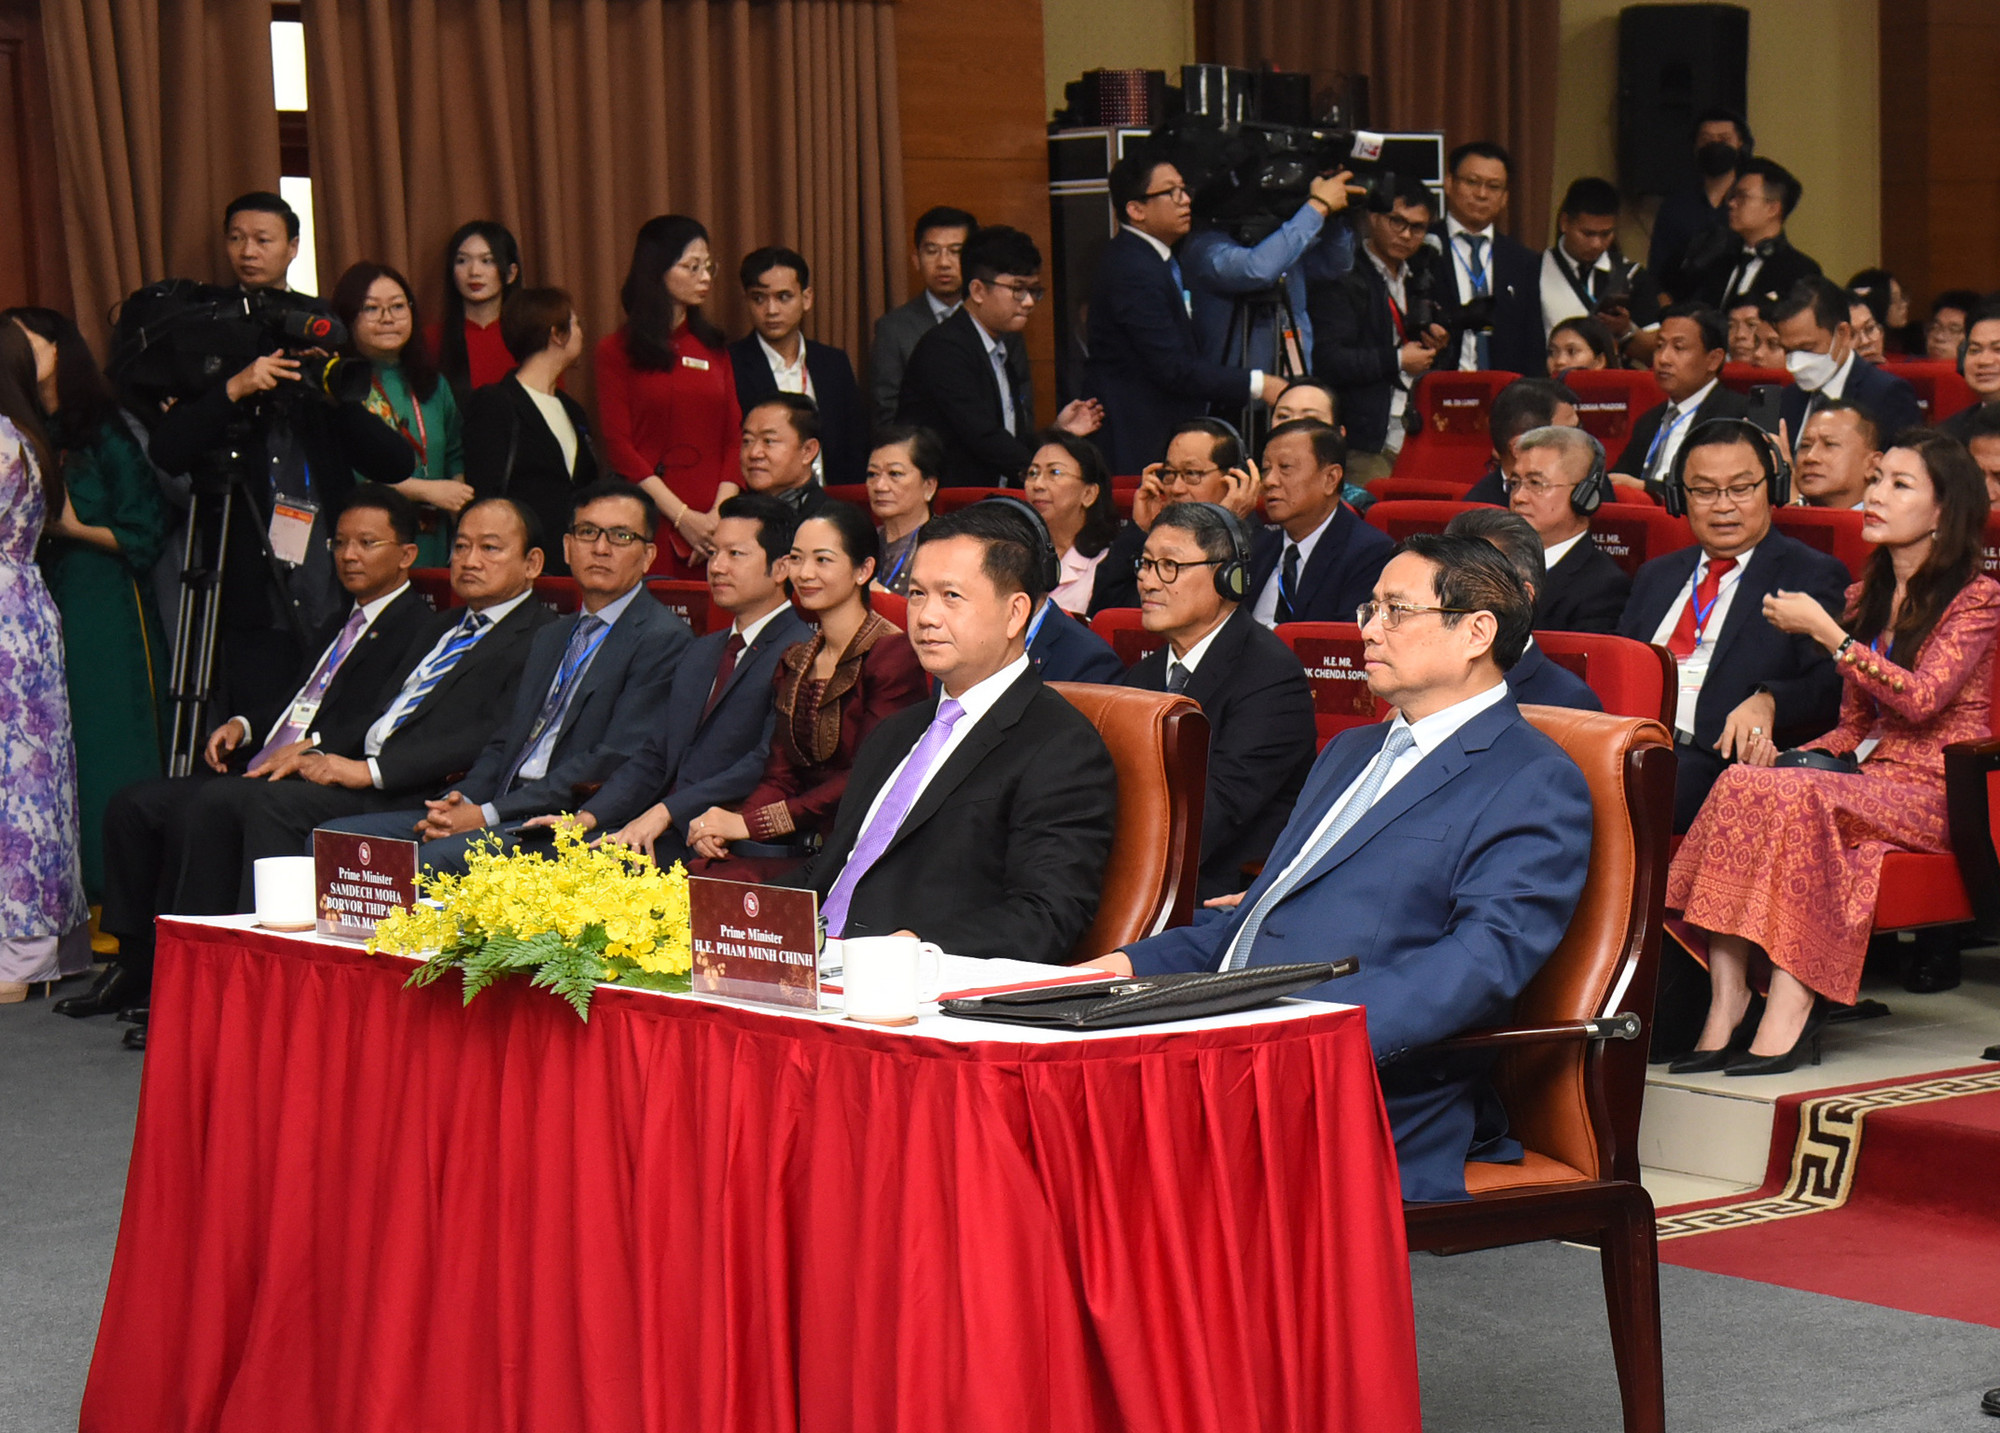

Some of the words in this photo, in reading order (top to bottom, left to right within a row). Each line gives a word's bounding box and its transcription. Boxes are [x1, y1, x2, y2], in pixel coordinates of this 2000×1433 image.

[1323, 656, 1338, 667] H.E.
[1338, 656, 1353, 668] MR.
[1314, 668, 1347, 680] CHENDA
[338, 866, 361, 882] Prime
[362, 869, 393, 886] Minister
[330, 882, 373, 899] SAMDECH
[374, 889, 402, 904] MOHA
[326, 896, 364, 914] BORVOR
[341, 913, 361, 928] HUN
[720, 924, 746, 940] Prime
[747, 927, 784, 945] Minister
[694, 938, 715, 954] H.E.
[716, 941, 746, 958] PHAM
[748, 945, 777, 962] MINH
[778, 950, 814, 967] CHINH
